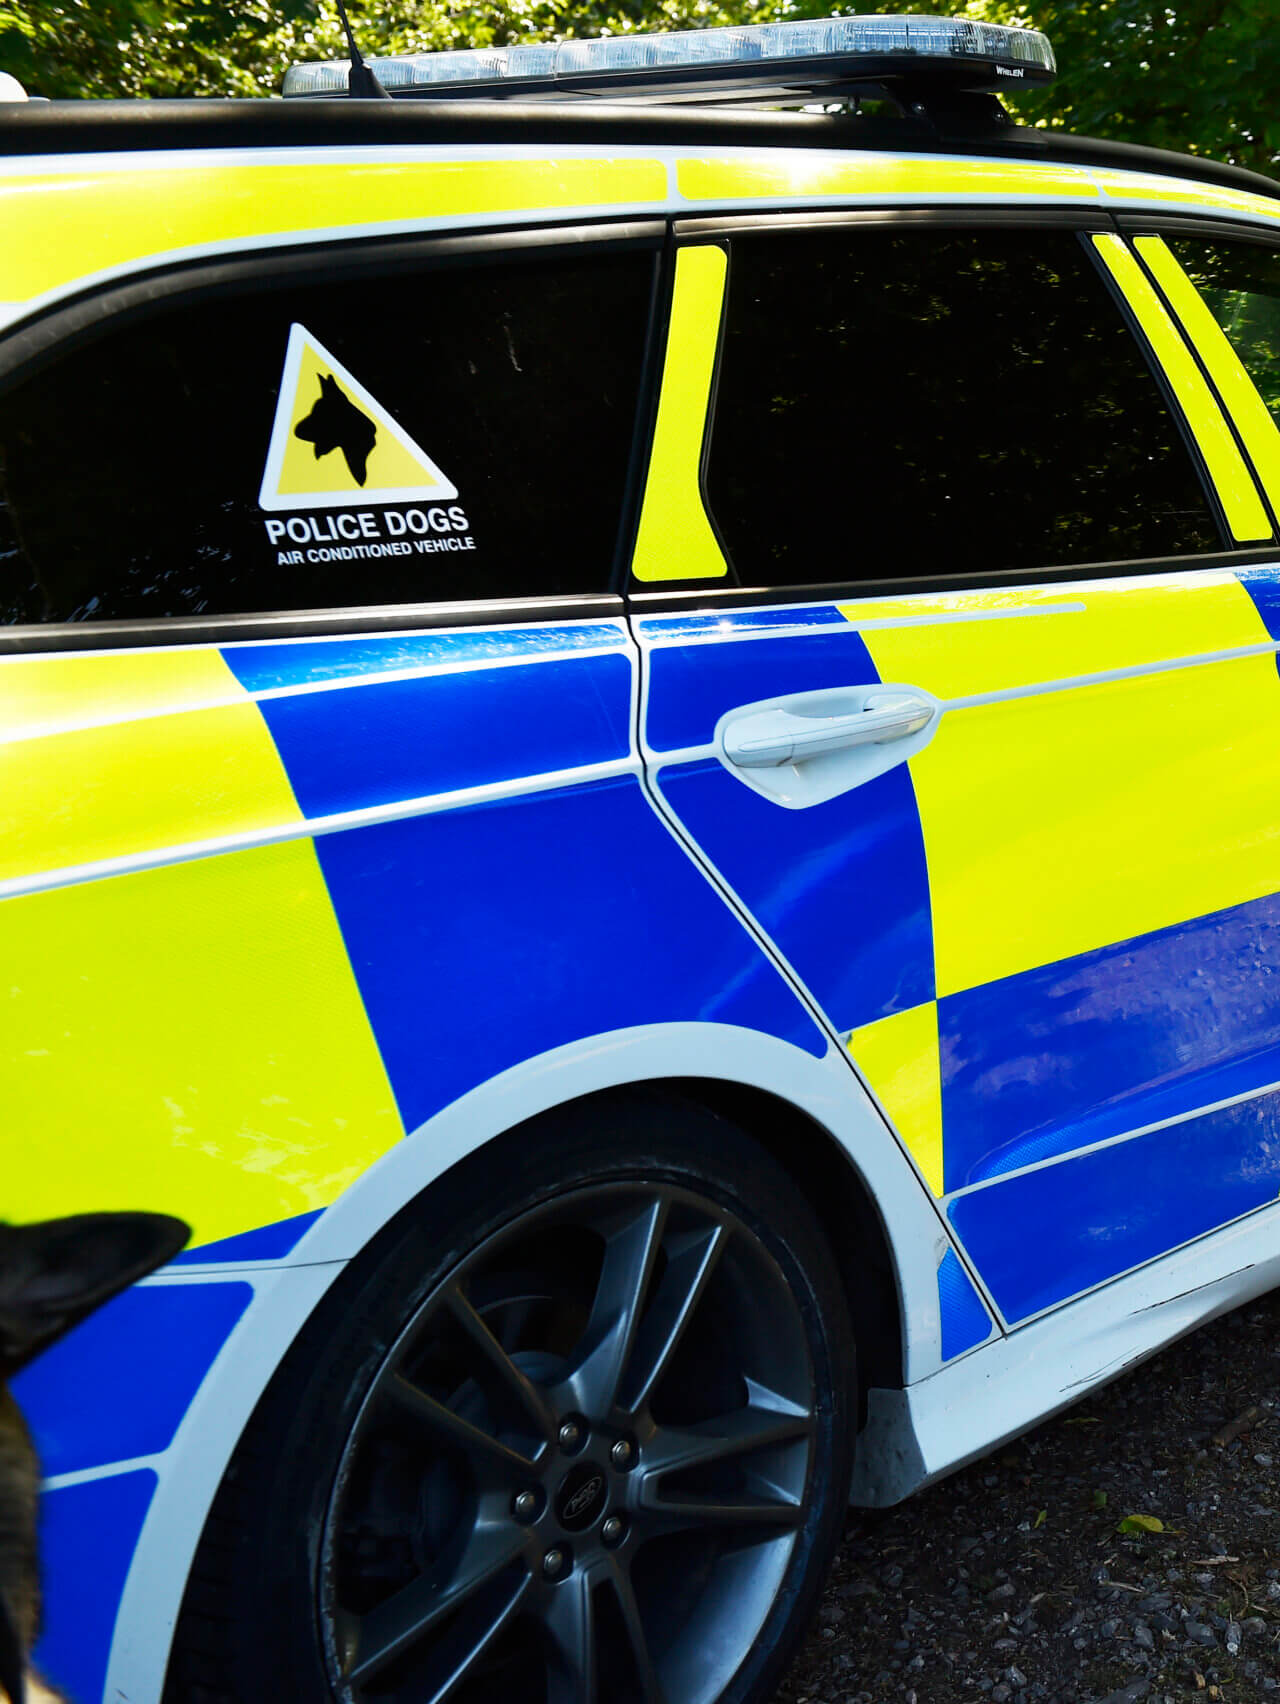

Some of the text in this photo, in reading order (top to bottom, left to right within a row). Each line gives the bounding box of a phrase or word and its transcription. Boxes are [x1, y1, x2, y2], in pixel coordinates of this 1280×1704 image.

[265, 507, 469, 545] POLICE DOGS
[277, 536, 477, 566] AIR CONDITIONED VEHICLE
